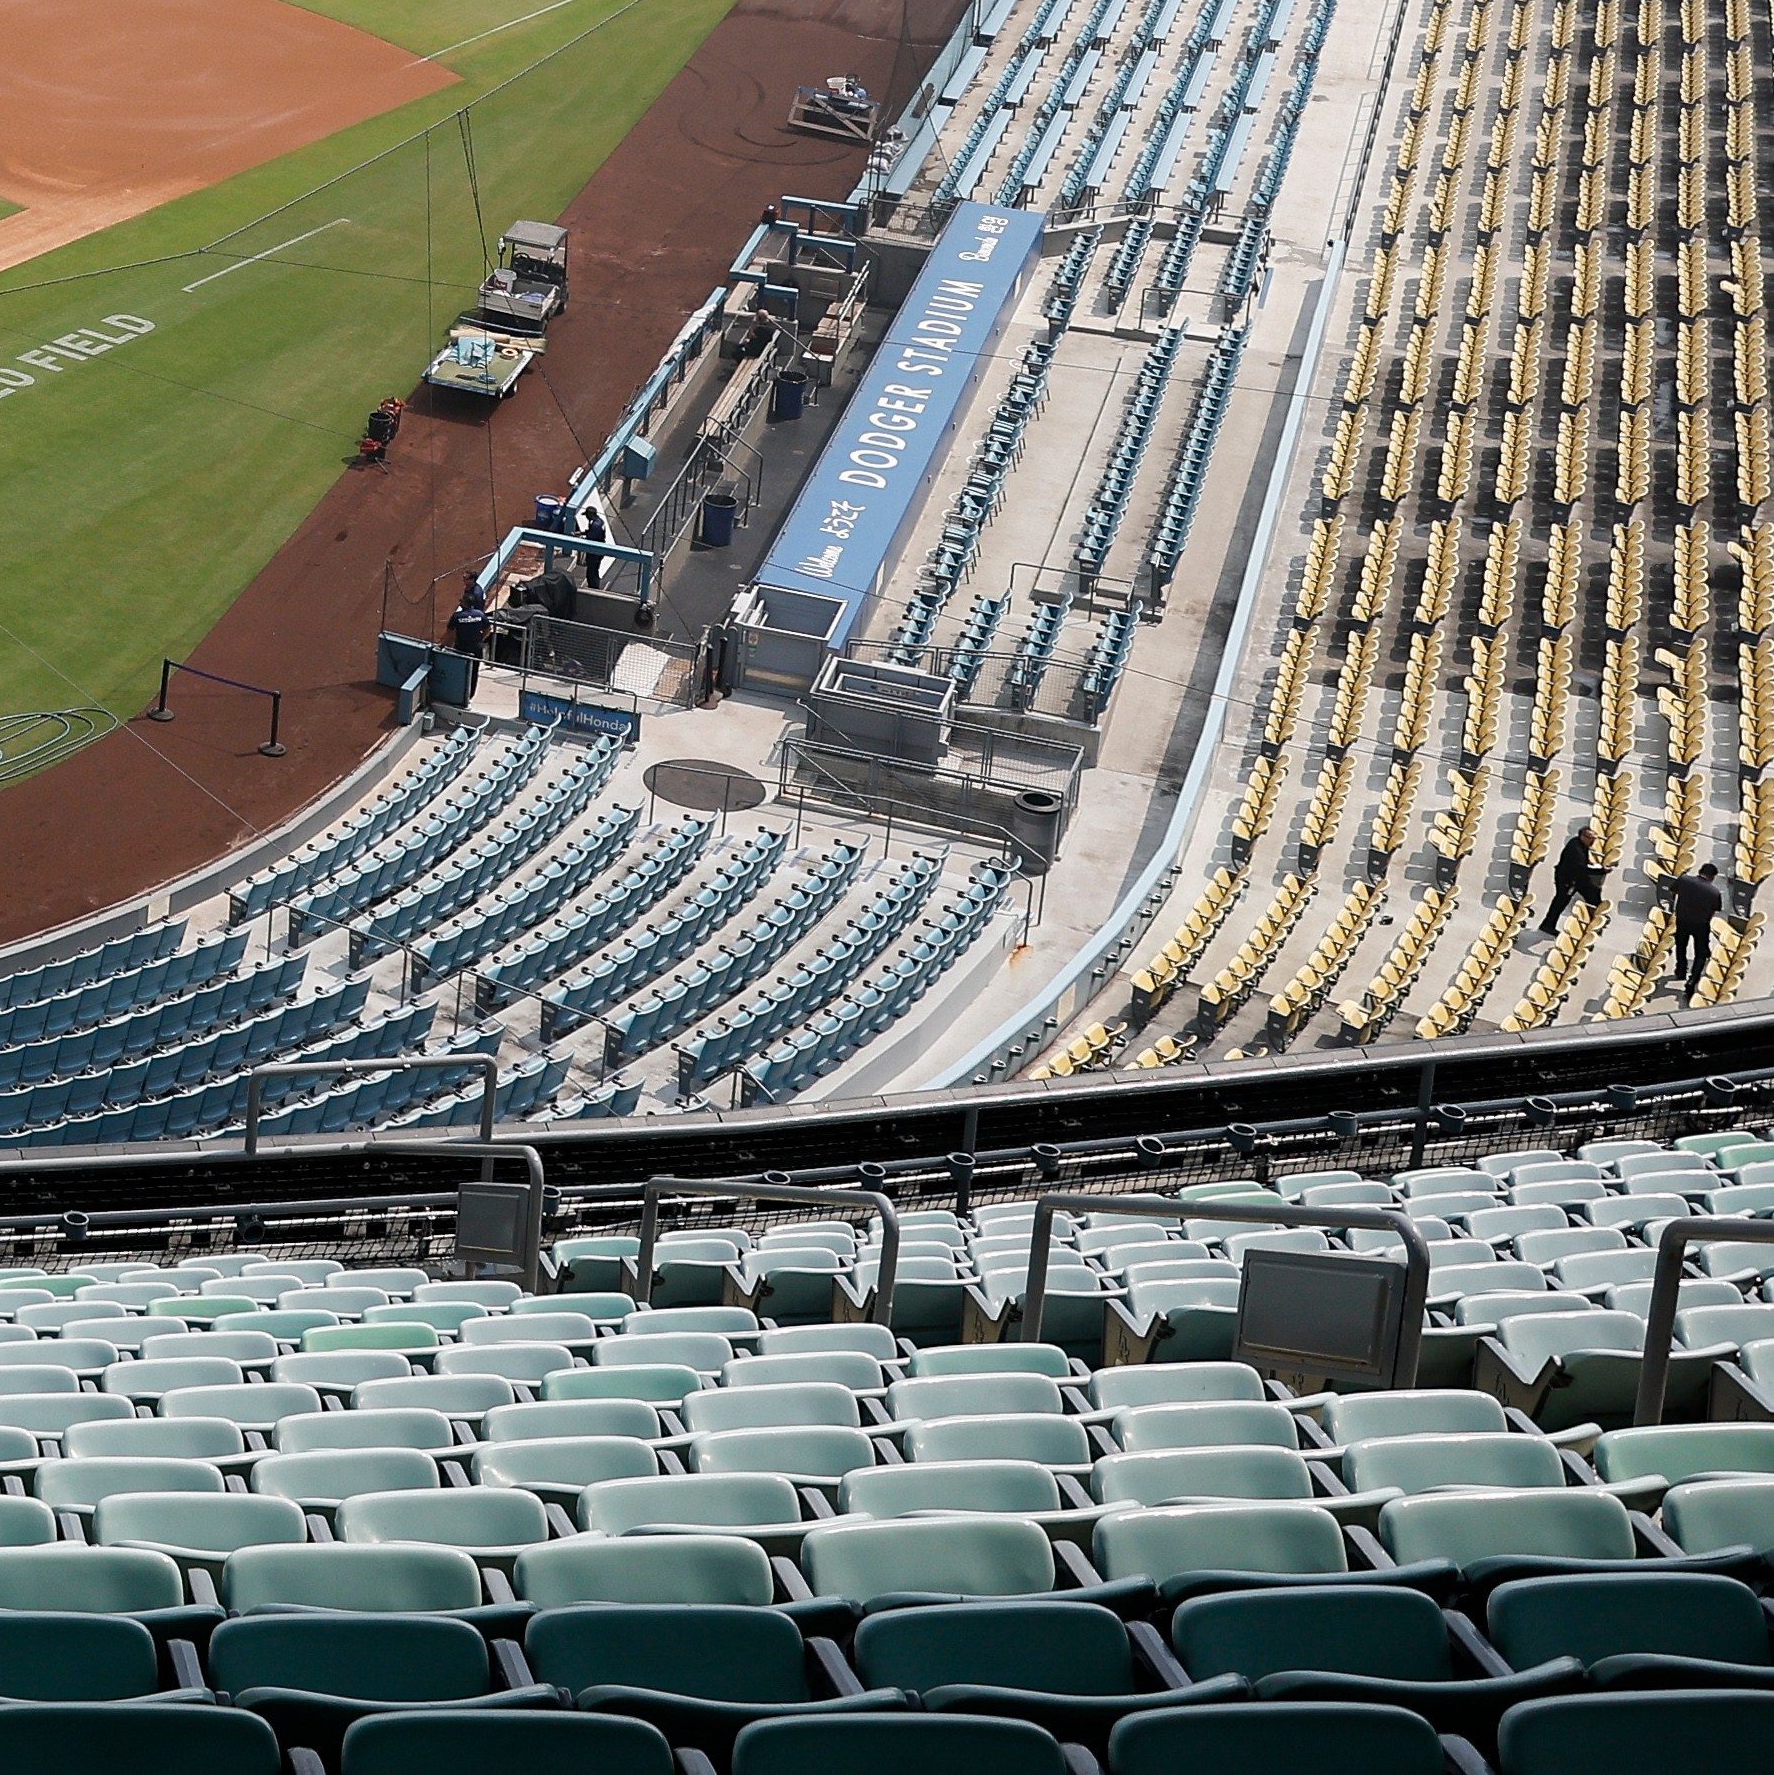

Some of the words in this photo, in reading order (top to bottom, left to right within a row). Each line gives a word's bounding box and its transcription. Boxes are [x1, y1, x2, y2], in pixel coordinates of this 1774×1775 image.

[16, 313, 155, 372] FIELD
[839, 383, 934, 490] DODGER
[898, 279, 985, 377] STADIUM
[819, 500, 866, 539] ようこそ
